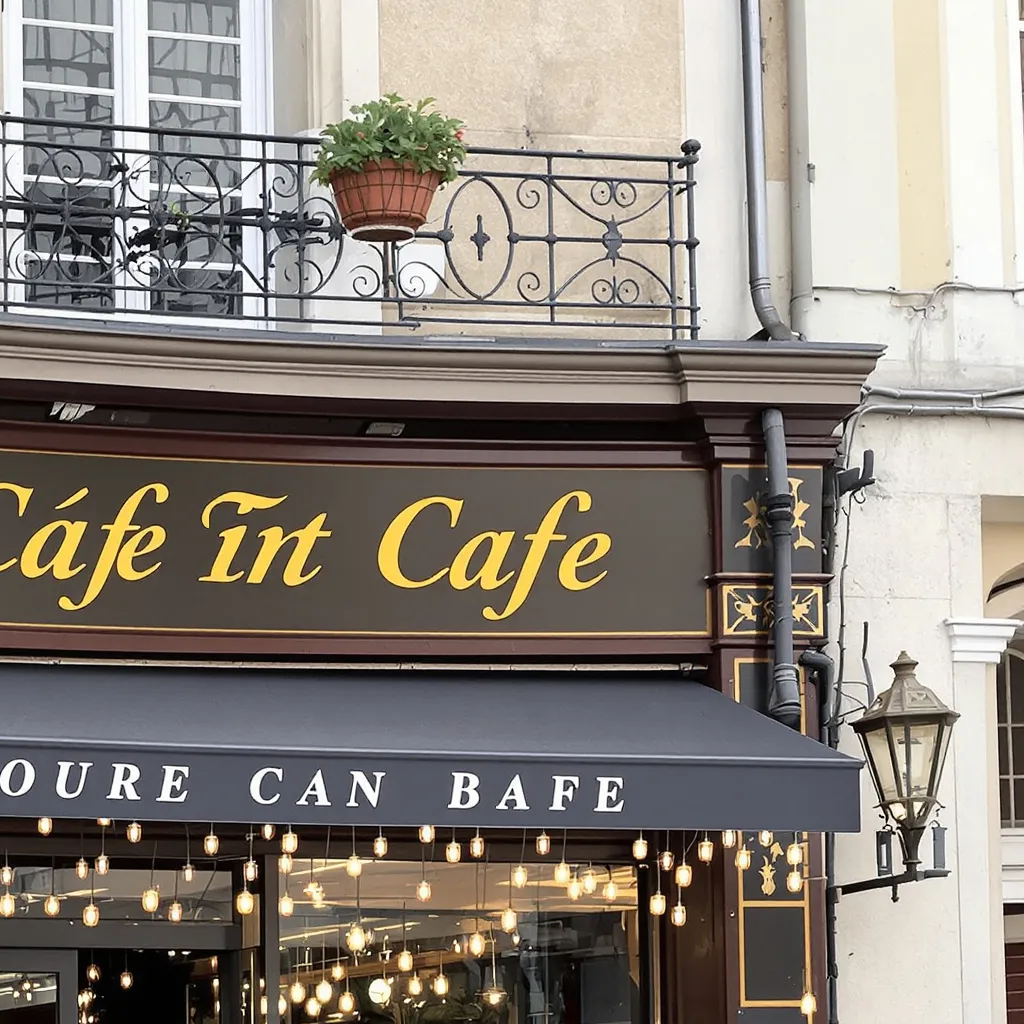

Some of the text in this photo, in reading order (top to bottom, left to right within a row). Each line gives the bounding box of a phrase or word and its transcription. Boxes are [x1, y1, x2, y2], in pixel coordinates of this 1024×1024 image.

[377, 490, 612, 621] Cafe
[249, 767, 387, 808] CAN
[447, 772, 625, 812] BAFE
